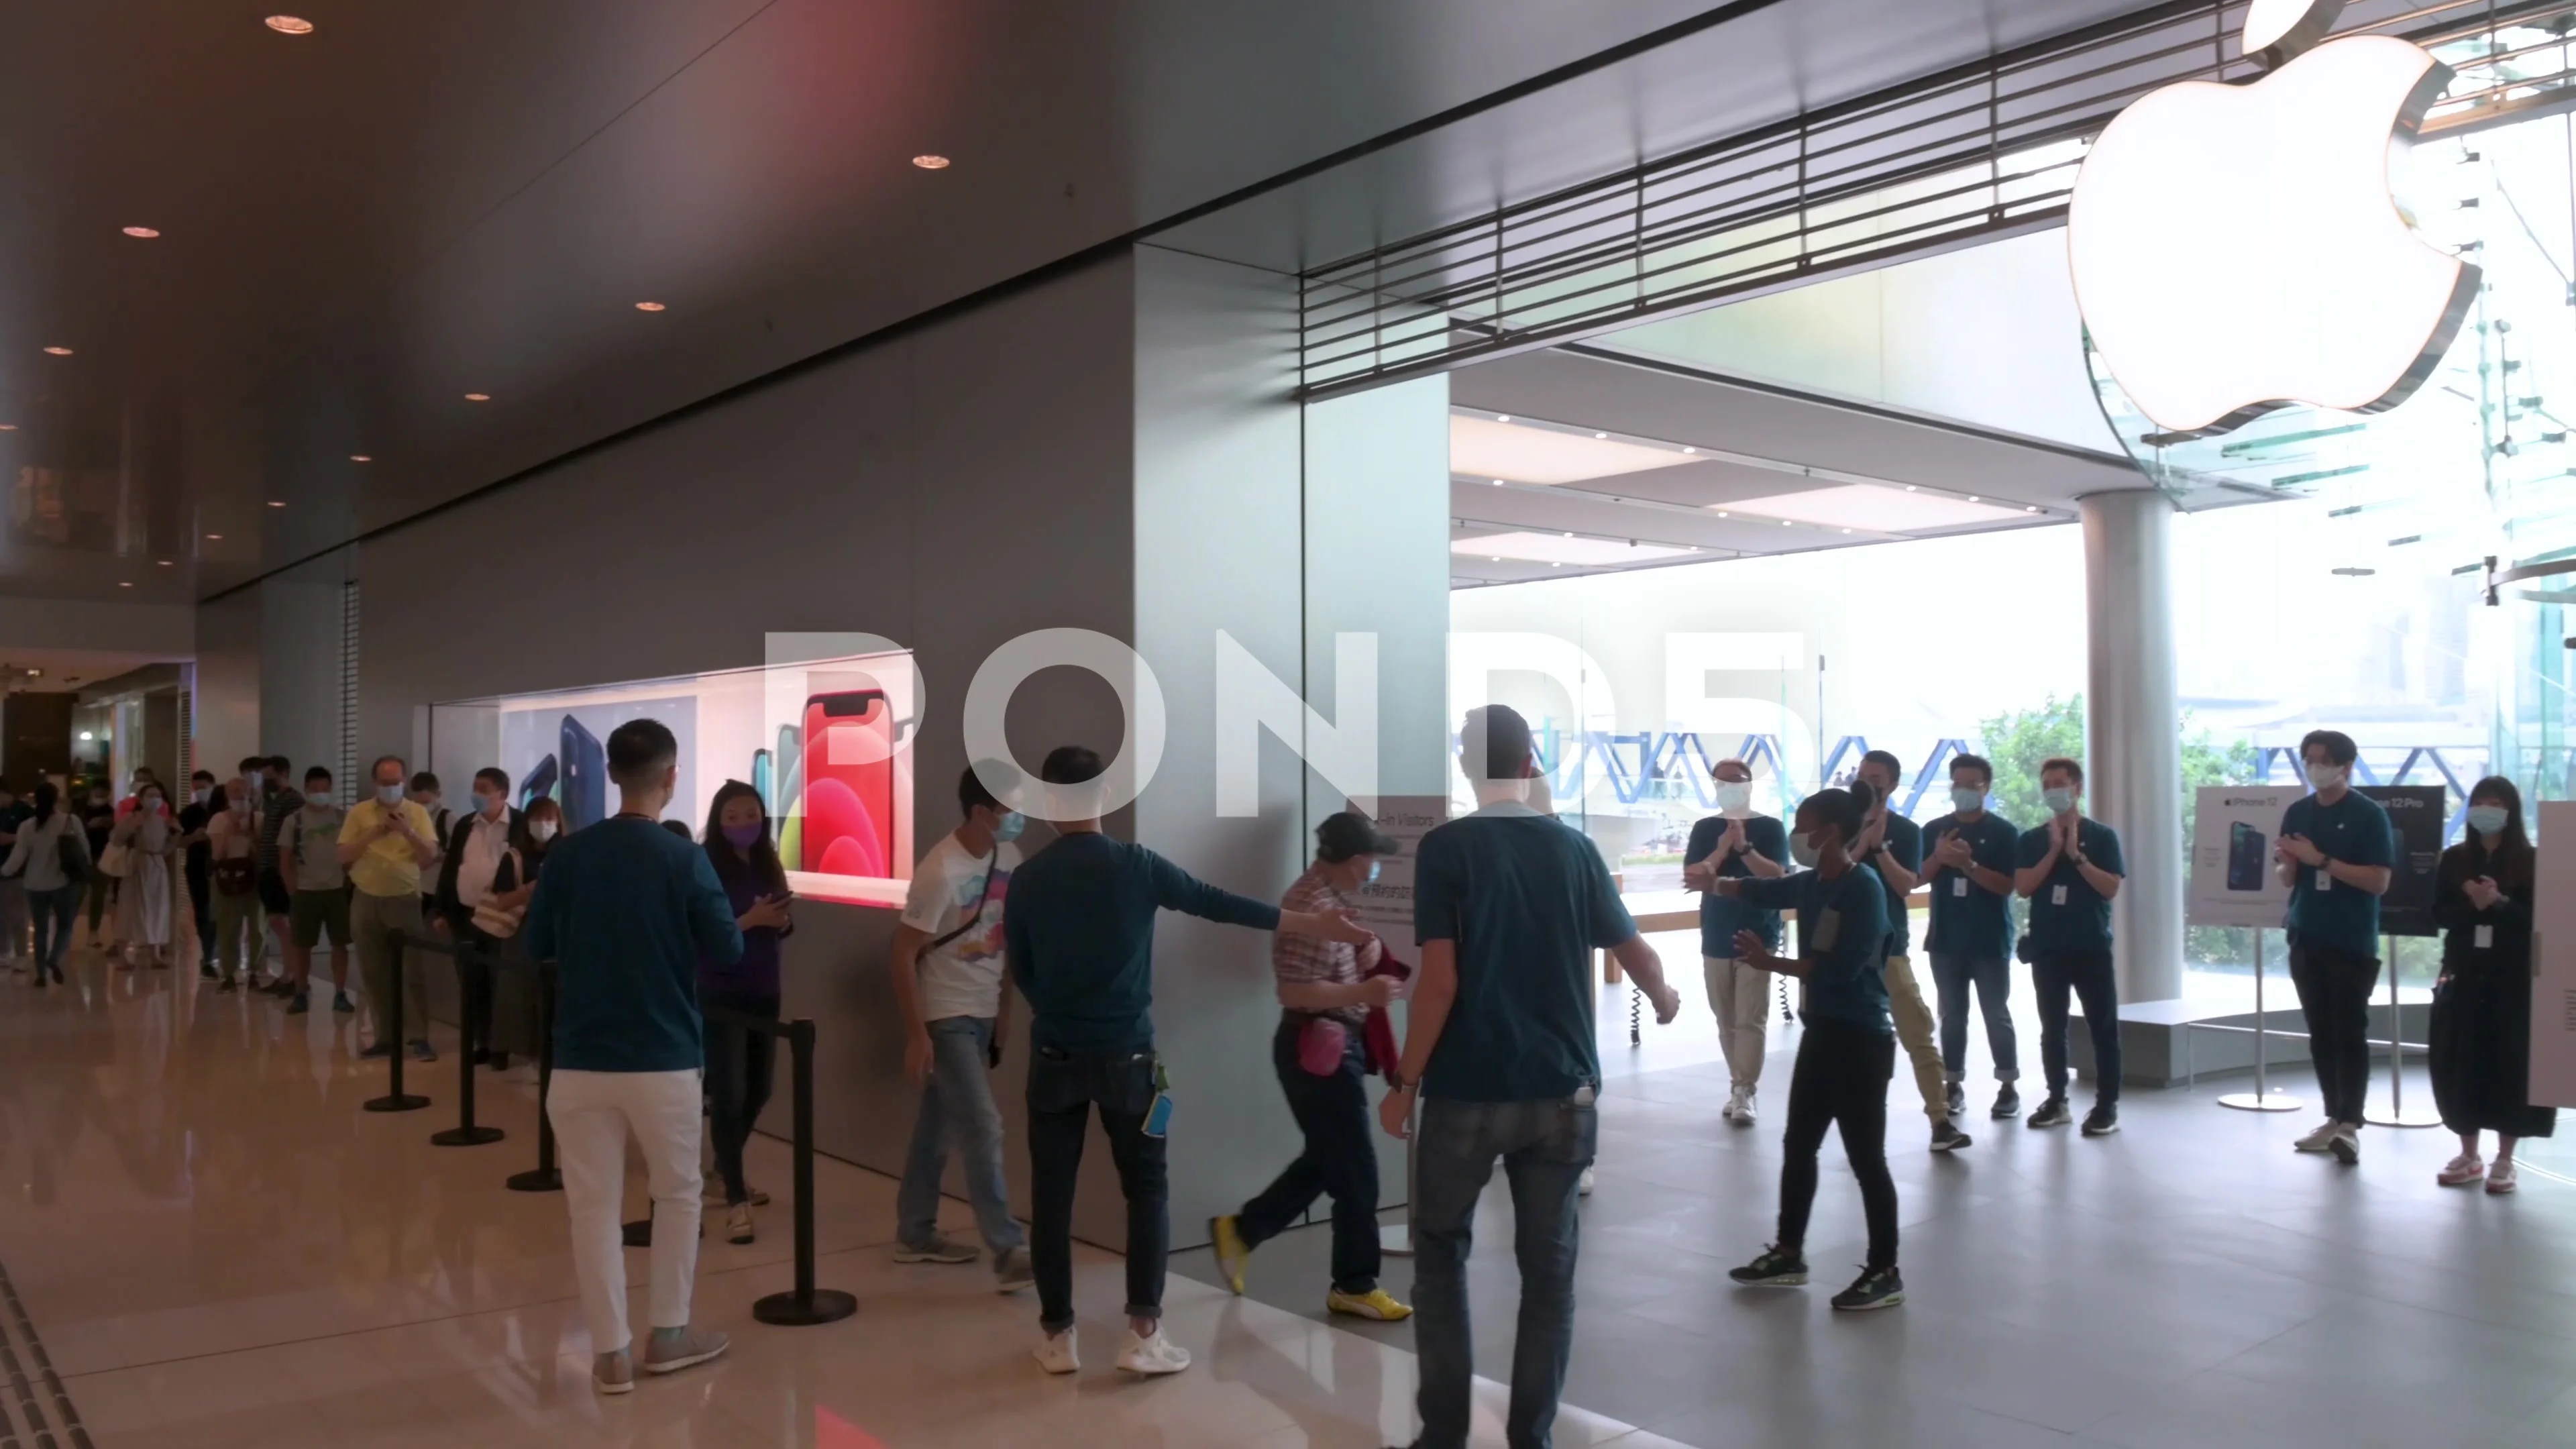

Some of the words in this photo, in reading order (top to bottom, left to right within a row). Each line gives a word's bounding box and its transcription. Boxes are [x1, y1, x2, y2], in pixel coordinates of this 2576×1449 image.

[2232, 797, 2266, 806] iPhone
[2391, 797, 2403, 808] 12
[2404, 797, 2424, 809] Pro
[1398, 812, 1435, 827] Visitors
